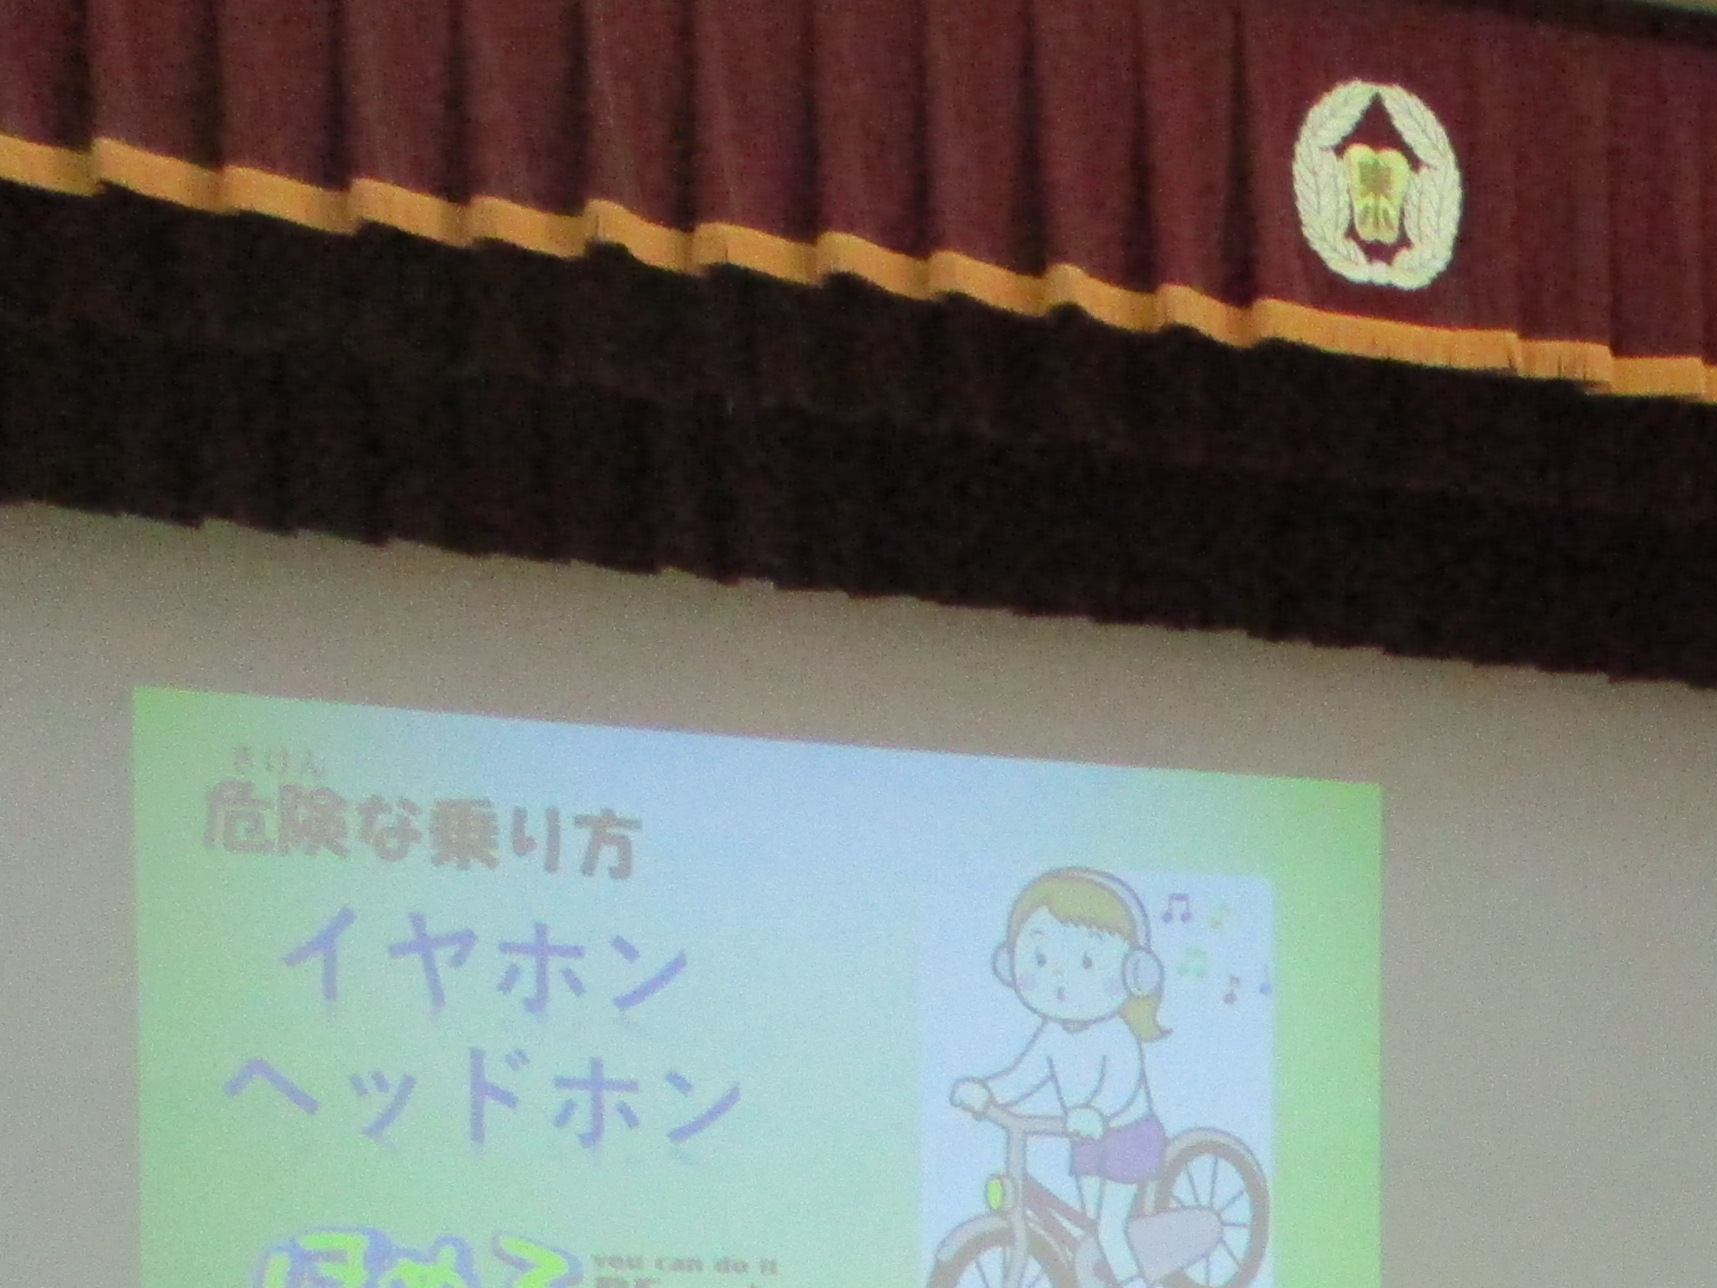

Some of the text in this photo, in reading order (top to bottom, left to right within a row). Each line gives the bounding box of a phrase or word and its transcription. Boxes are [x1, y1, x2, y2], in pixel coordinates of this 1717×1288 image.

[203, 779, 643, 881] 危険な乗り方
[283, 906, 688, 1012] イヤホン
[223, 1046, 742, 1148] ヘッドホン
